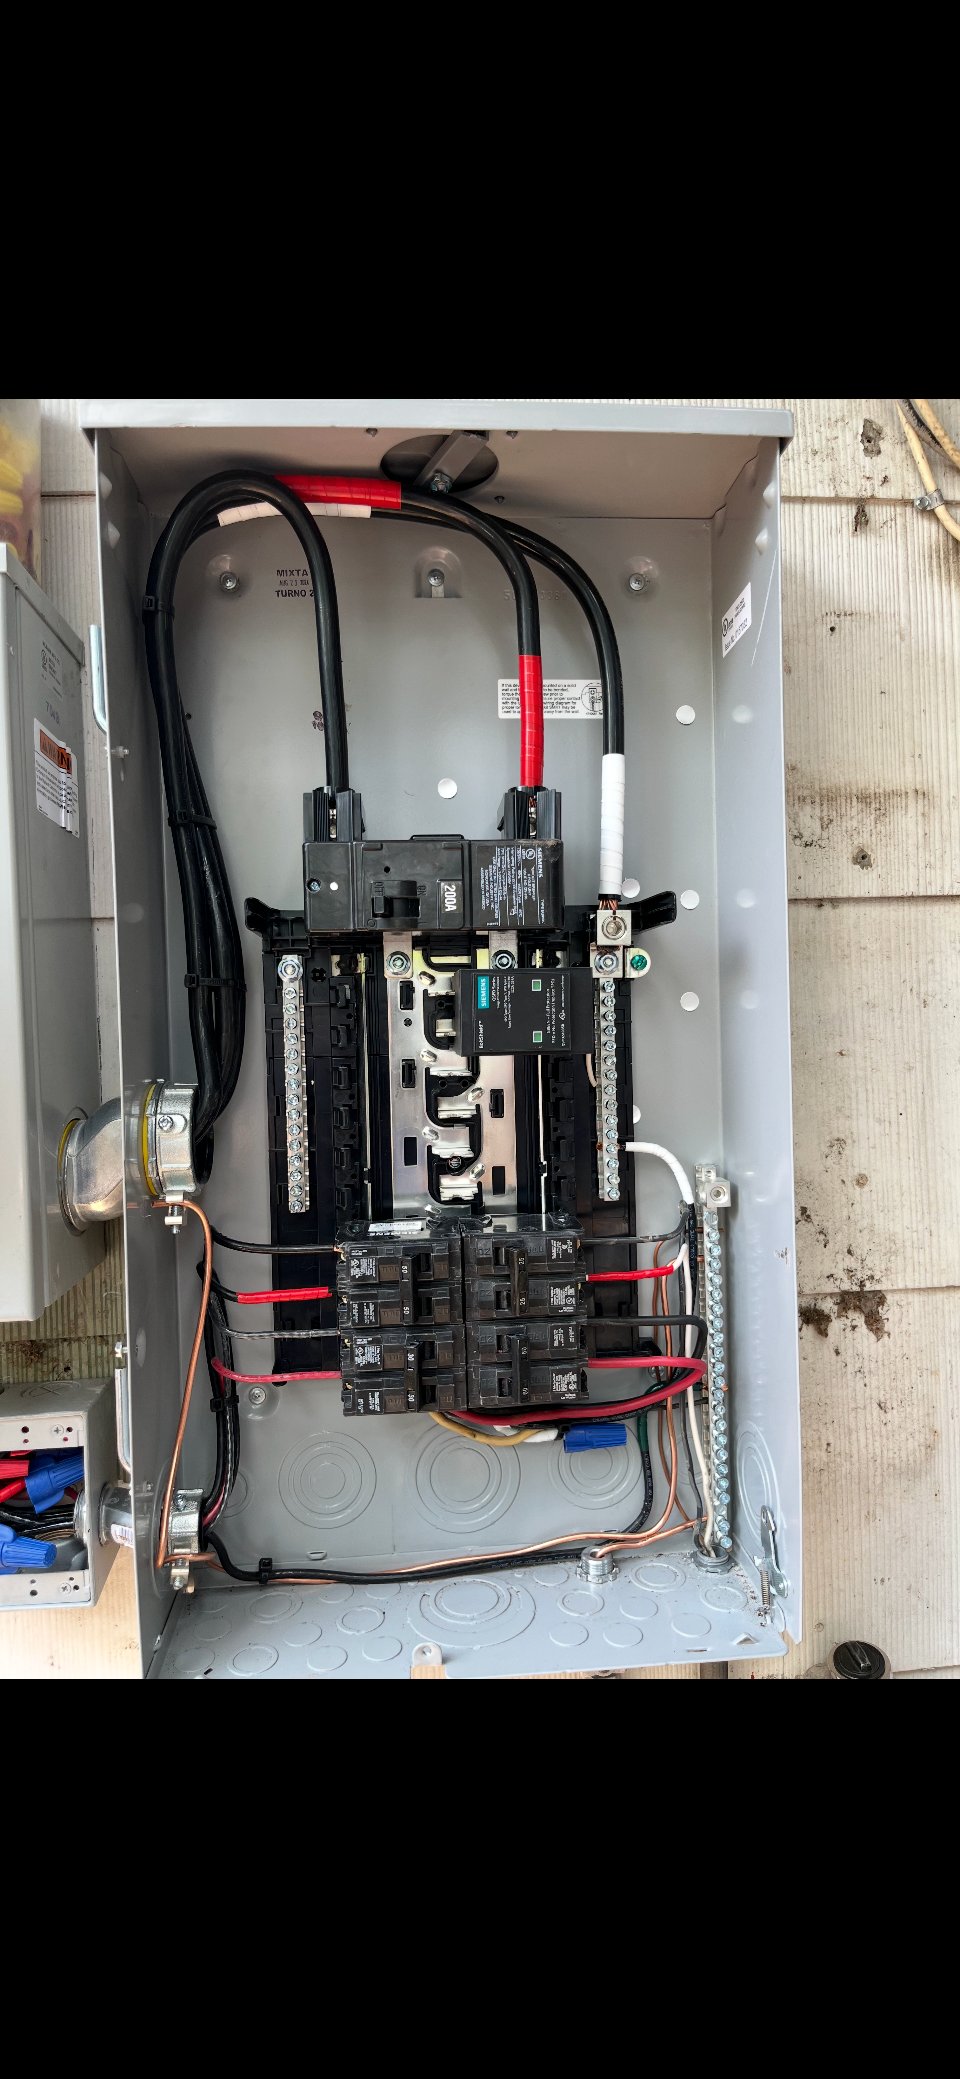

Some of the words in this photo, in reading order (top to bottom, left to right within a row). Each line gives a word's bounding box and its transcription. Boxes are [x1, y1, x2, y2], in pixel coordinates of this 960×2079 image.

[276, 569, 308, 577] MIXTA
[444, 885, 457, 912] 200A
[518, 1257, 525, 1265] 25
[403, 1306, 410, 1315] 50
[407, 1352, 415, 1361] 30
